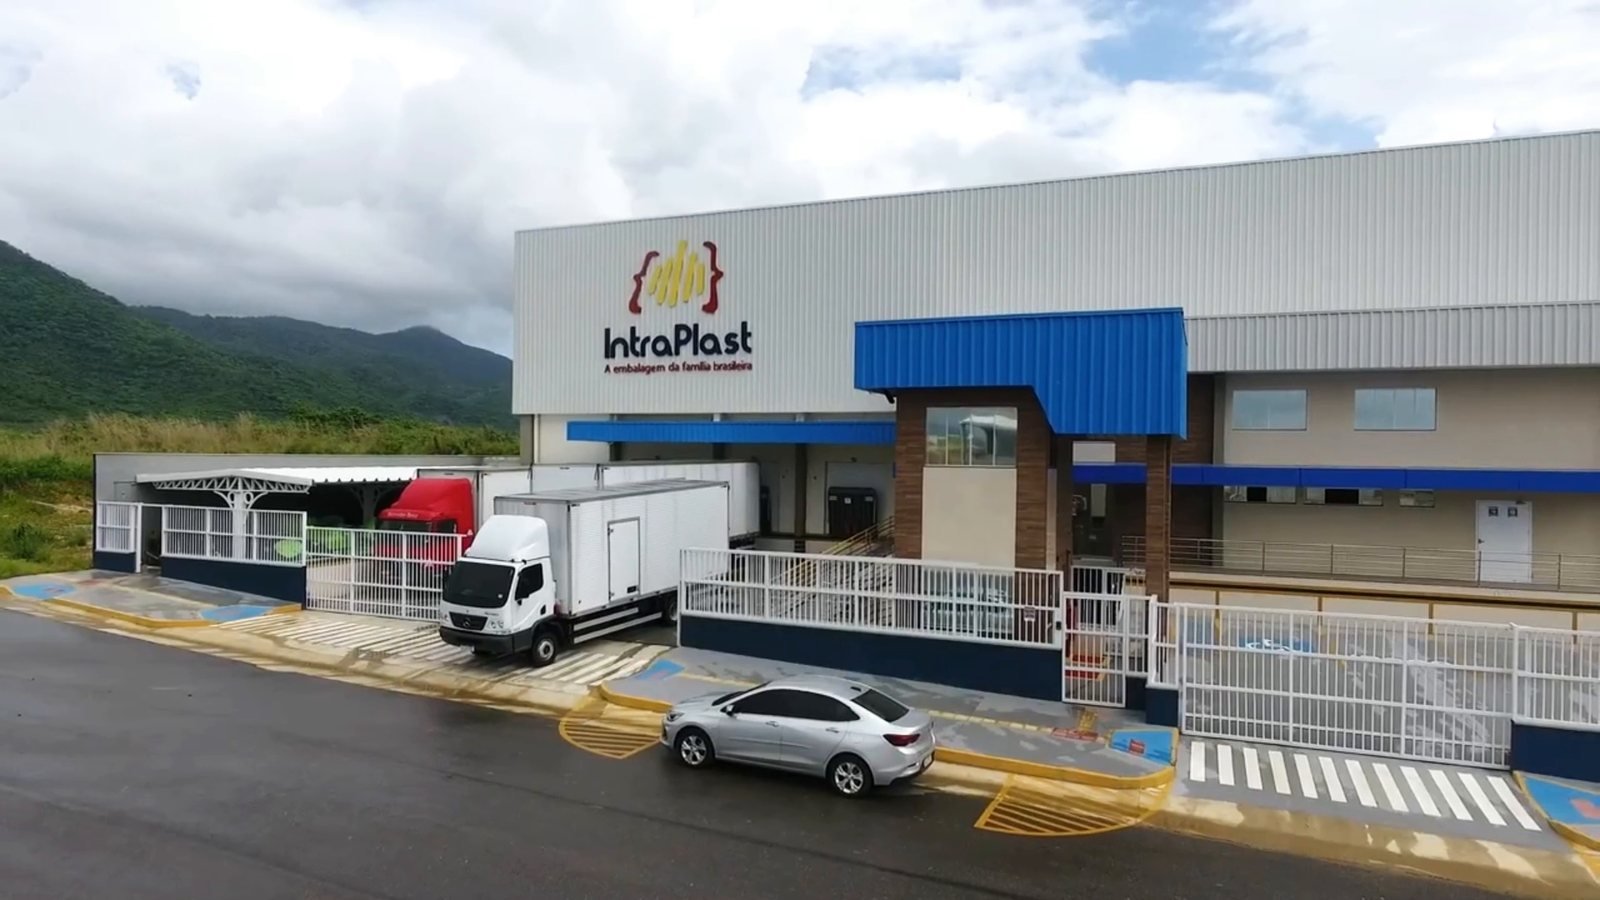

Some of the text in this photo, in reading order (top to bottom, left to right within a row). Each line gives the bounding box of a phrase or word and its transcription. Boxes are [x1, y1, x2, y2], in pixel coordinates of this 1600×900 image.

[604, 321, 752, 359] IntraPlast
[604, 364, 611, 374] A
[613, 362, 666, 375] embalagem
[668, 362, 680, 372] da
[713, 360, 753, 371] brasileira
